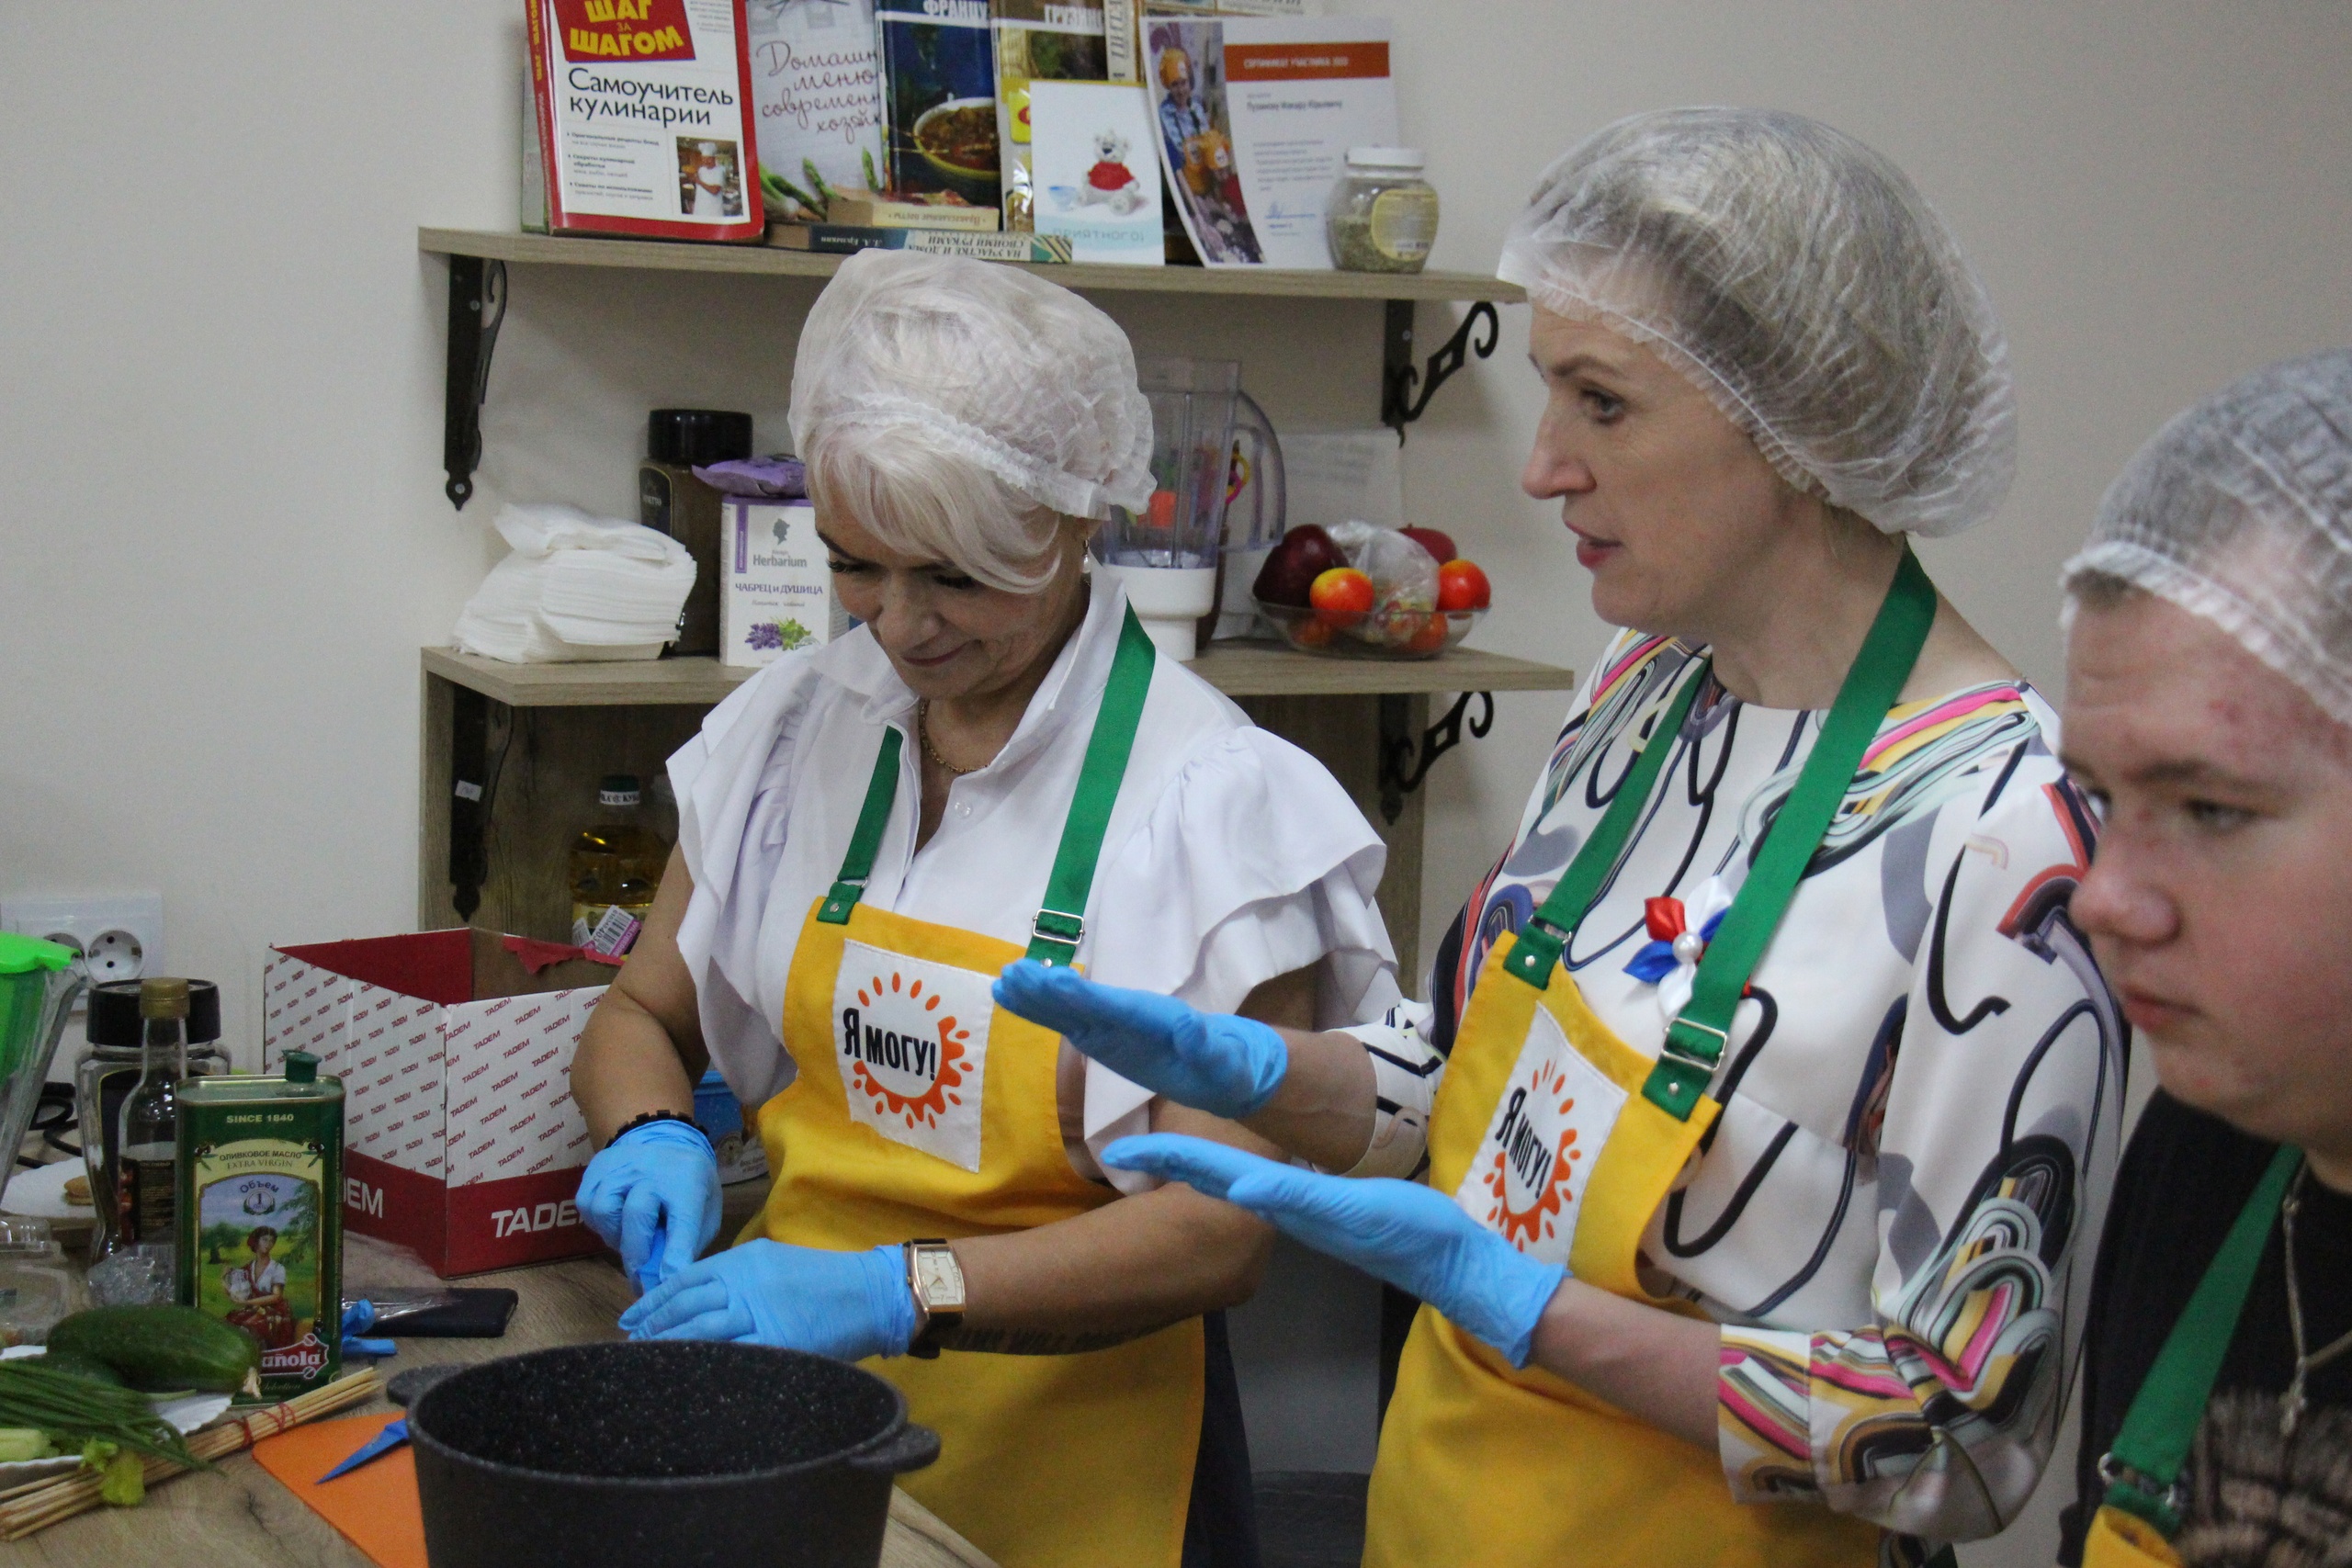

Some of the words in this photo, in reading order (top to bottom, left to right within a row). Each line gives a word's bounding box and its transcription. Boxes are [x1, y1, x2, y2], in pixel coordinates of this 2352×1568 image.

[570, 26, 684, 57] ШАГОМ
[569, 67, 734, 106] Самоучитель
[570, 96, 711, 129] кулинарии
[752, 554, 808, 568] Herbarium
[735, 582, 773, 593] ЧАБРЕЦ
[780, 583, 823, 595] ДУШИЦА
[485, 998, 511, 1017] TADEM
[514, 1006, 541, 1025] TADEM
[446, 1021, 471, 1042] TADEM
[544, 1014, 571, 1034] TADEM
[842, 1007, 862, 1059] Я
[474, 1030, 501, 1050] TADEM
[503, 1038, 530, 1058] TADEM
[532, 1047, 560, 1067] TADEM
[462, 1063, 490, 1084] TADEM
[492, 1071, 518, 1092] TADEM
[521, 1080, 548, 1100] TADEM
[450, 1097, 478, 1118] TADEM
[481, 1105, 507, 1125] TADEM
[1494, 1087, 1527, 1148] Я
[226, 1114, 263, 1123] SINCE
[266, 1113, 295, 1122] 1840
[509, 1112, 537, 1134] TADEM
[431, 1129, 446, 1140] TADE
[538, 1121, 565, 1142] TADEM
[219, 1150, 271, 1162] ОЛИВКОВОЕ
[272, 1150, 302, 1159] МАСЛО
[469, 1138, 495, 1159] TADEM
[498, 1146, 525, 1168] TADEM
[227, 1159, 255, 1170] EXTRA
[257, 1158, 293, 1168] VIRGIN
[526, 1154, 554, 1176] TADEM
[239, 1179, 280, 1193] Объем
[491, 1199, 586, 1238] TADE
[262, 1350, 322, 1368] añola
